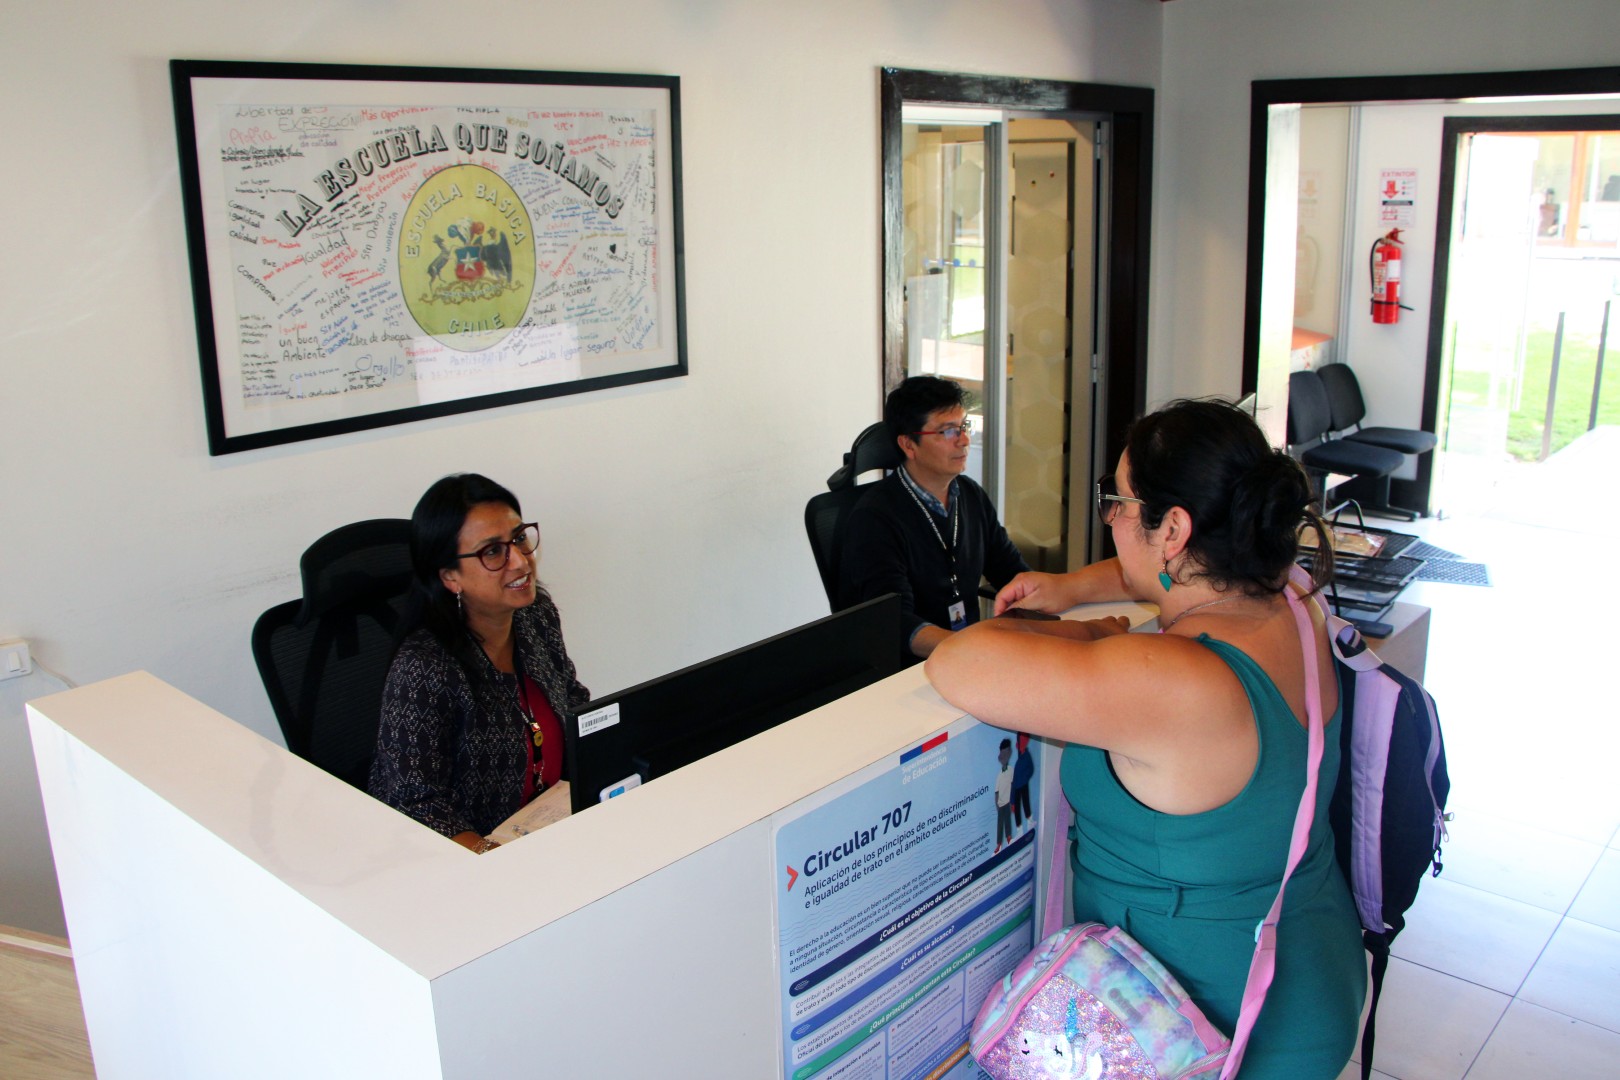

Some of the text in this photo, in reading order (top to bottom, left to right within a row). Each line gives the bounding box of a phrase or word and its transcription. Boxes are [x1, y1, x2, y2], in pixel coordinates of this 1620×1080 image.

[275, 193, 324, 237] LA
[313, 124, 449, 202] ESCUELA
[453, 122, 507, 154] QUE
[514, 131, 624, 219] SOÑAMOS
[405, 183, 527, 257] ESCUELA BASICA
[448, 312, 506, 338] CHILE
[902, 756, 947, 784] de Educación
[803, 800, 912, 876] Circular 707
[804, 785, 988, 896] Aplicación de los principios de no discriminación
[805, 809, 966, 908] e igualdad de trato en el ámbito educativo
[796, 937, 818, 953] derecho
[829, 915, 856, 933] educación
[871, 899, 881, 909] bien
[882, 887, 901, 902] superior
[902, 881, 910, 890] que
[879, 923, 896, 941] ¿Cuál
[897, 920, 903, 928] es
[904, 914, 910, 923] el
[911, 900, 933, 918] objetivo
[934, 894, 941, 902] de
[948, 873, 972, 893] Circular?
[794, 946, 817, 962] ninguna
[900, 925, 954, 969] ¿Cuál es su alcance?
[869, 1015, 885, 1032] ¿Qué
[886, 995, 913, 1021] principios
[914, 975, 939, 998] sustentan
[940, 966, 951, 977] esta
[952, 947, 975, 968] Circular?
